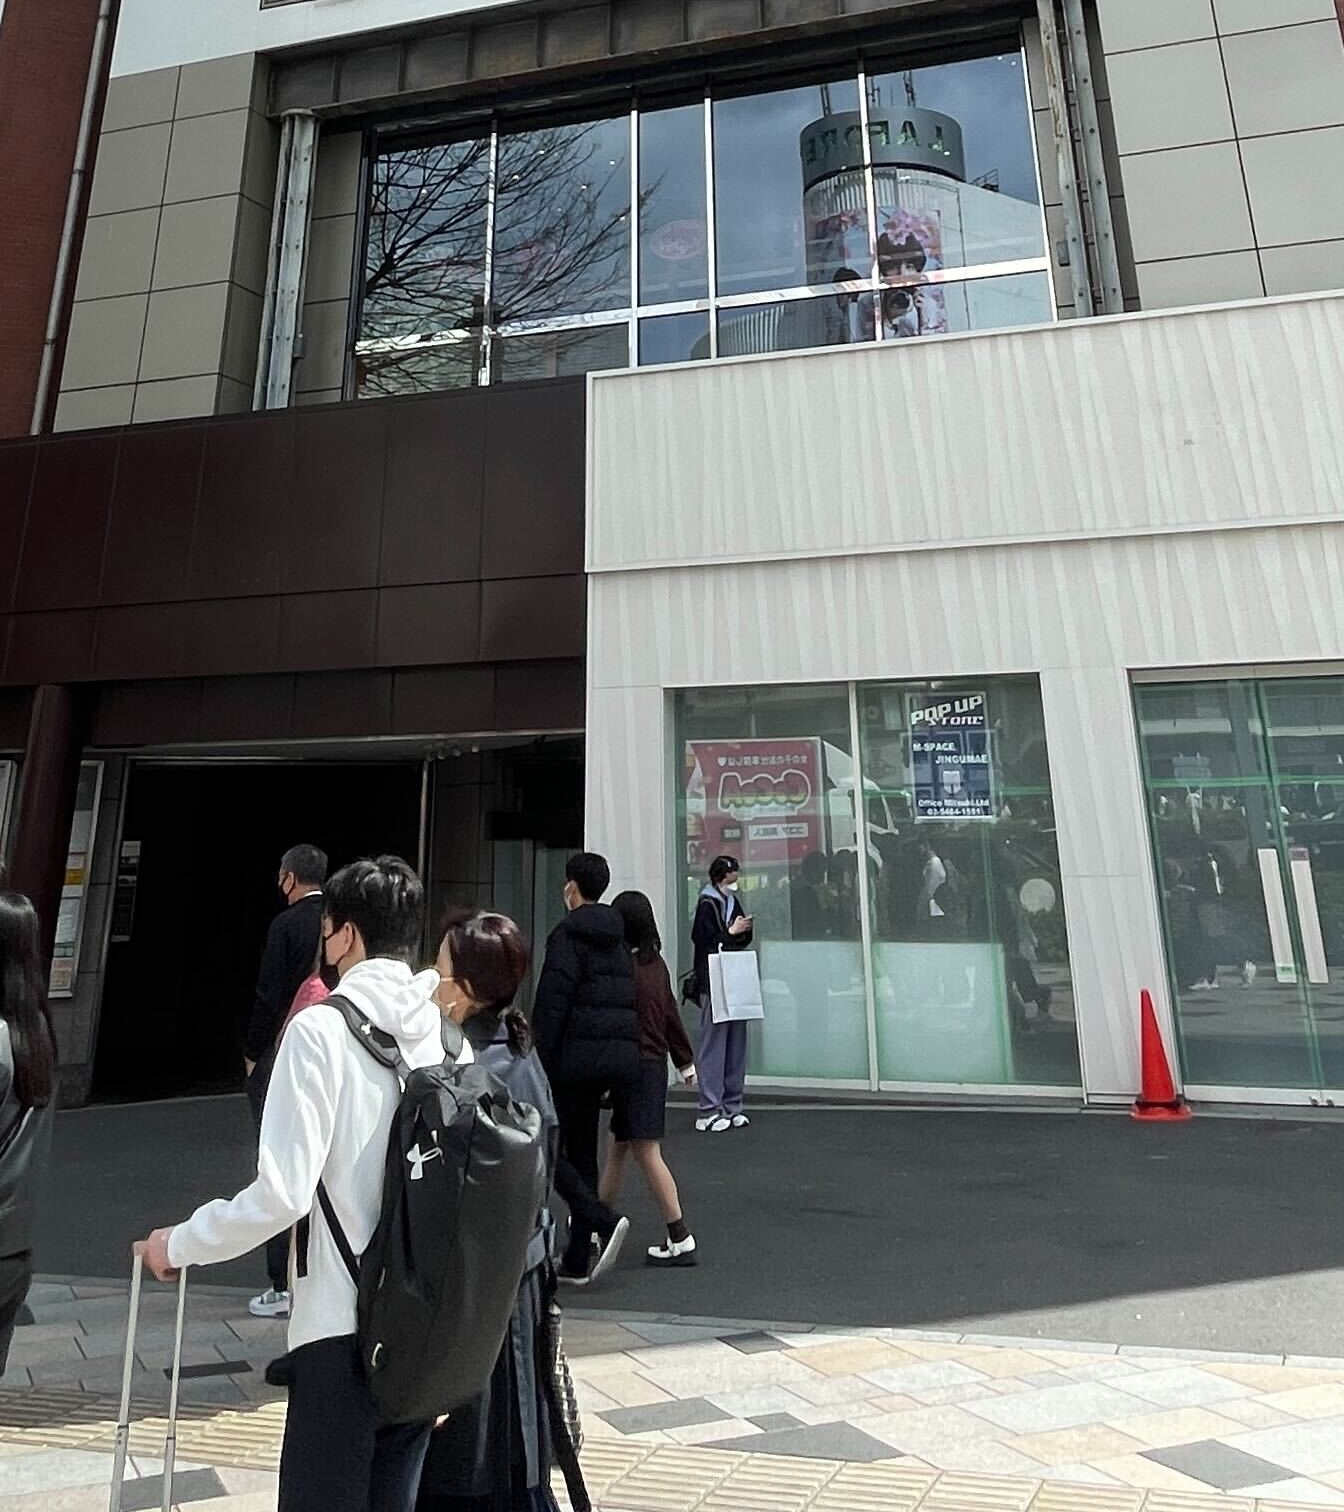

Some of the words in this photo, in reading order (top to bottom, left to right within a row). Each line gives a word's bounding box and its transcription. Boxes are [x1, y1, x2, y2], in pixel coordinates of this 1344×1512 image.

[911, 702, 951, 726] POP
[954, 695, 983, 713] UP
[913, 742, 955, 752] M-SPACE
[935, 753, 988, 764] JINGUMAE
